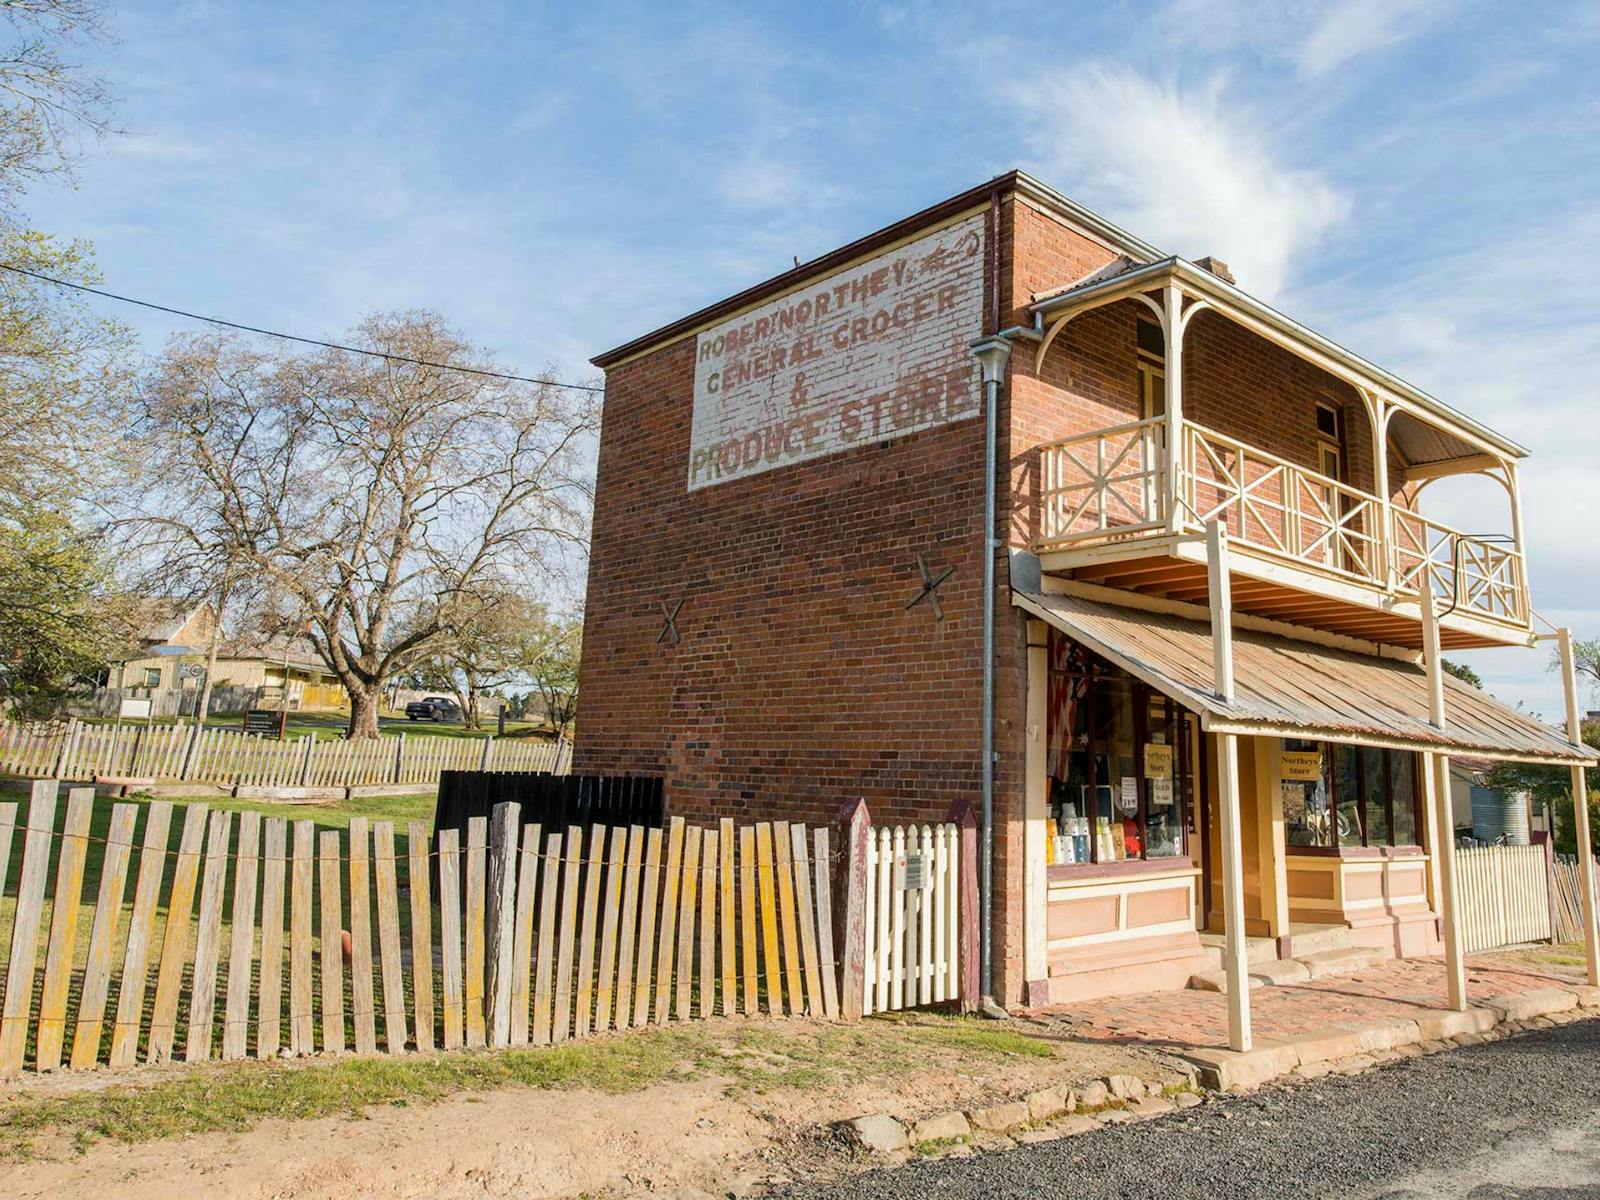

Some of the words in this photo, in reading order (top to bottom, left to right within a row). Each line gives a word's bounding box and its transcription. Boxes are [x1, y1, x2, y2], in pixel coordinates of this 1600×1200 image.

[707, 336, 823, 394] GENERAL
[832, 284, 956, 350] GROCER
[790, 371, 812, 408] &
[690, 411, 831, 482] PRODUCE
[839, 366, 975, 443] STORE
